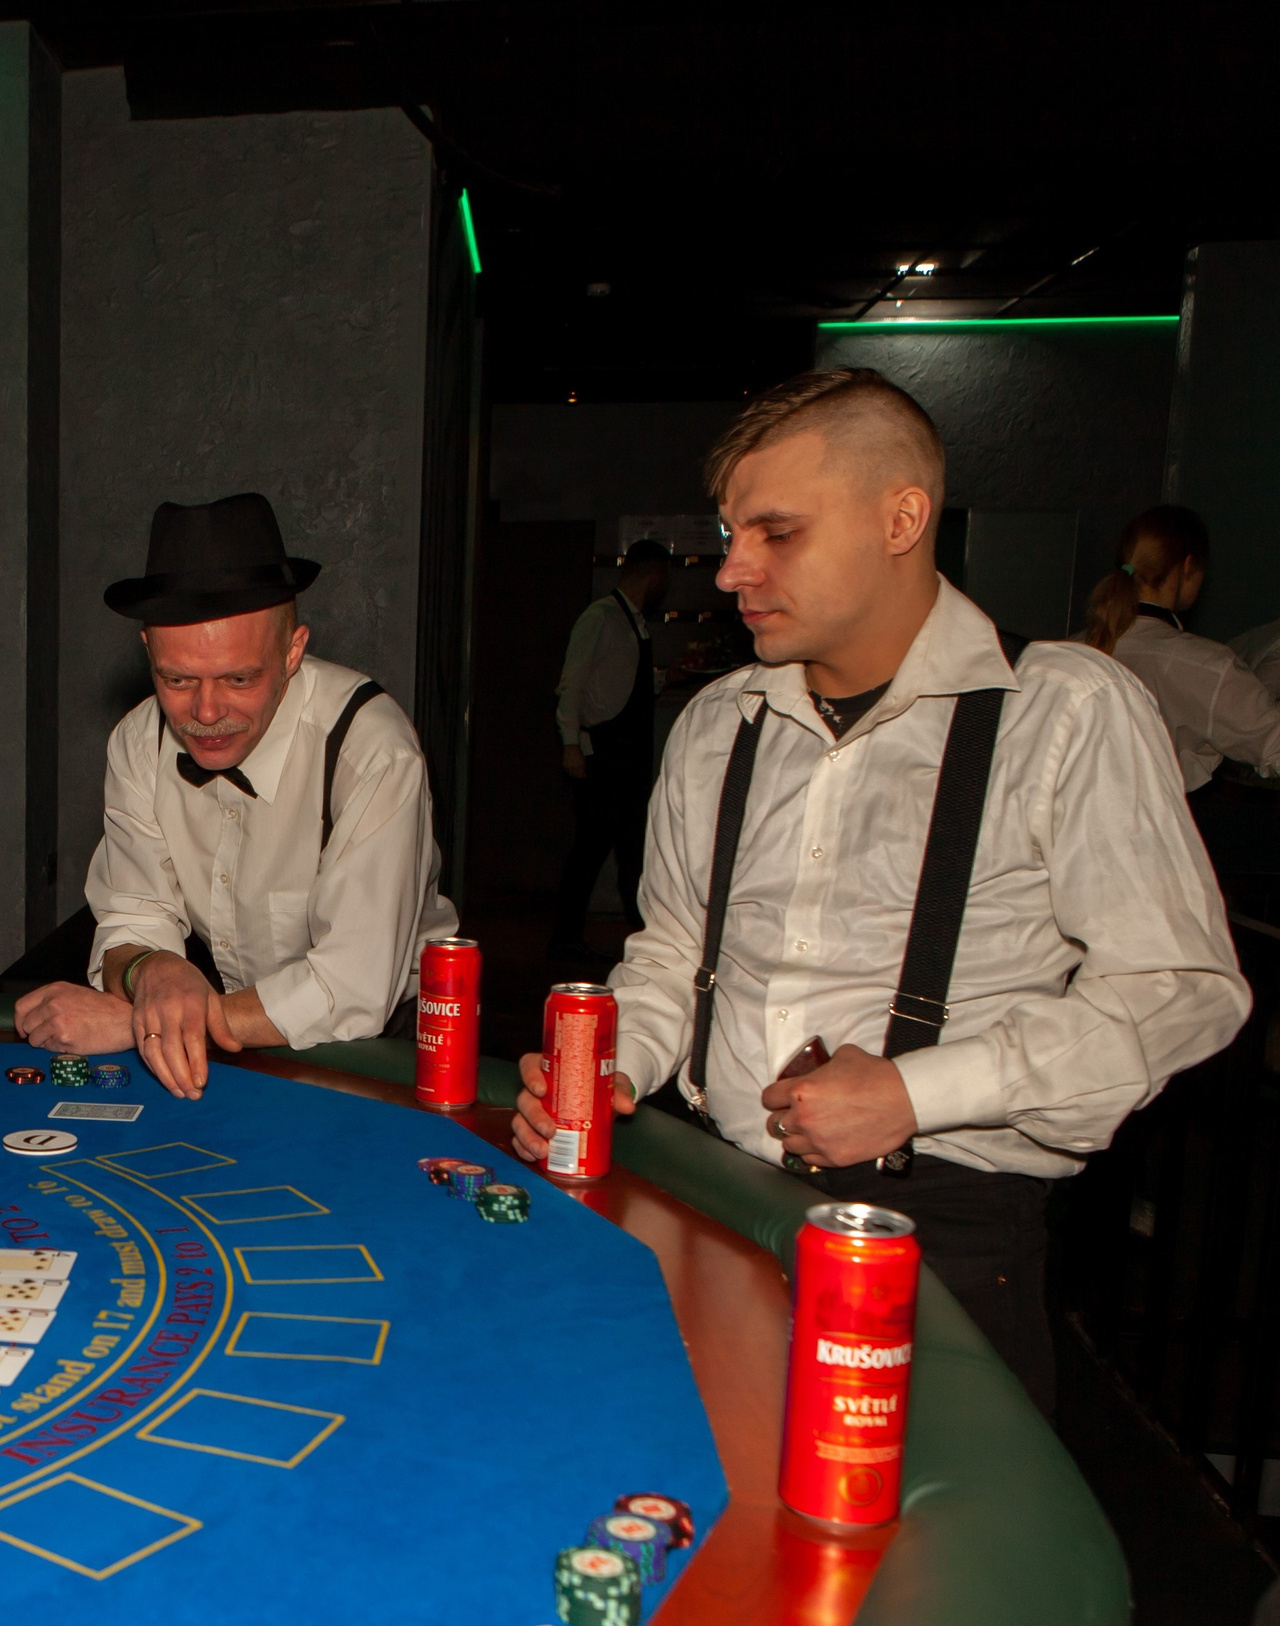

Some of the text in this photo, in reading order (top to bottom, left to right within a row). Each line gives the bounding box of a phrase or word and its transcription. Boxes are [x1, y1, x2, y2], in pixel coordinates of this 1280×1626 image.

[419, 998, 461, 1017] ŠOVICE
[28, 1180, 69, 1195] 16
[65, 1195, 93, 1208] to
[83, 1209, 128, 1239] draw
[109, 1241, 146, 1275] must
[174, 1241, 208, 1260] to
[175, 1267, 214, 1277] 2
[110, 1278, 146, 1308] and
[166, 1281, 215, 1326] PAYS
[93, 1310, 135, 1330] 17
[82, 1335, 121, 1358] on
[11, 1359, 96, 1413] stand
